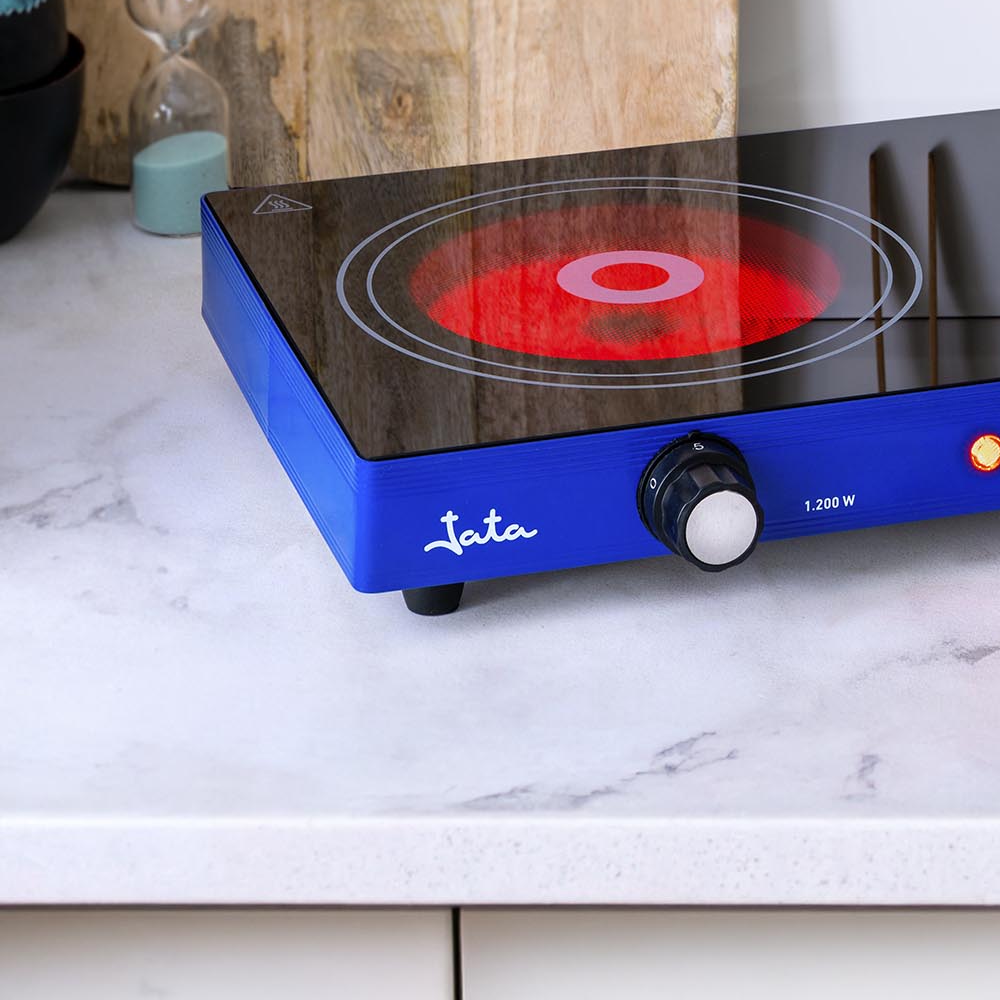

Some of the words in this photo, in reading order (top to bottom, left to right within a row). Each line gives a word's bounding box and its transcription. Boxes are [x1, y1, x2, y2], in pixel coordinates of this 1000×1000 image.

[804, 496, 839, 512] 1.200
[842, 494, 856, 507] W
[423, 508, 538, 556] Jata
